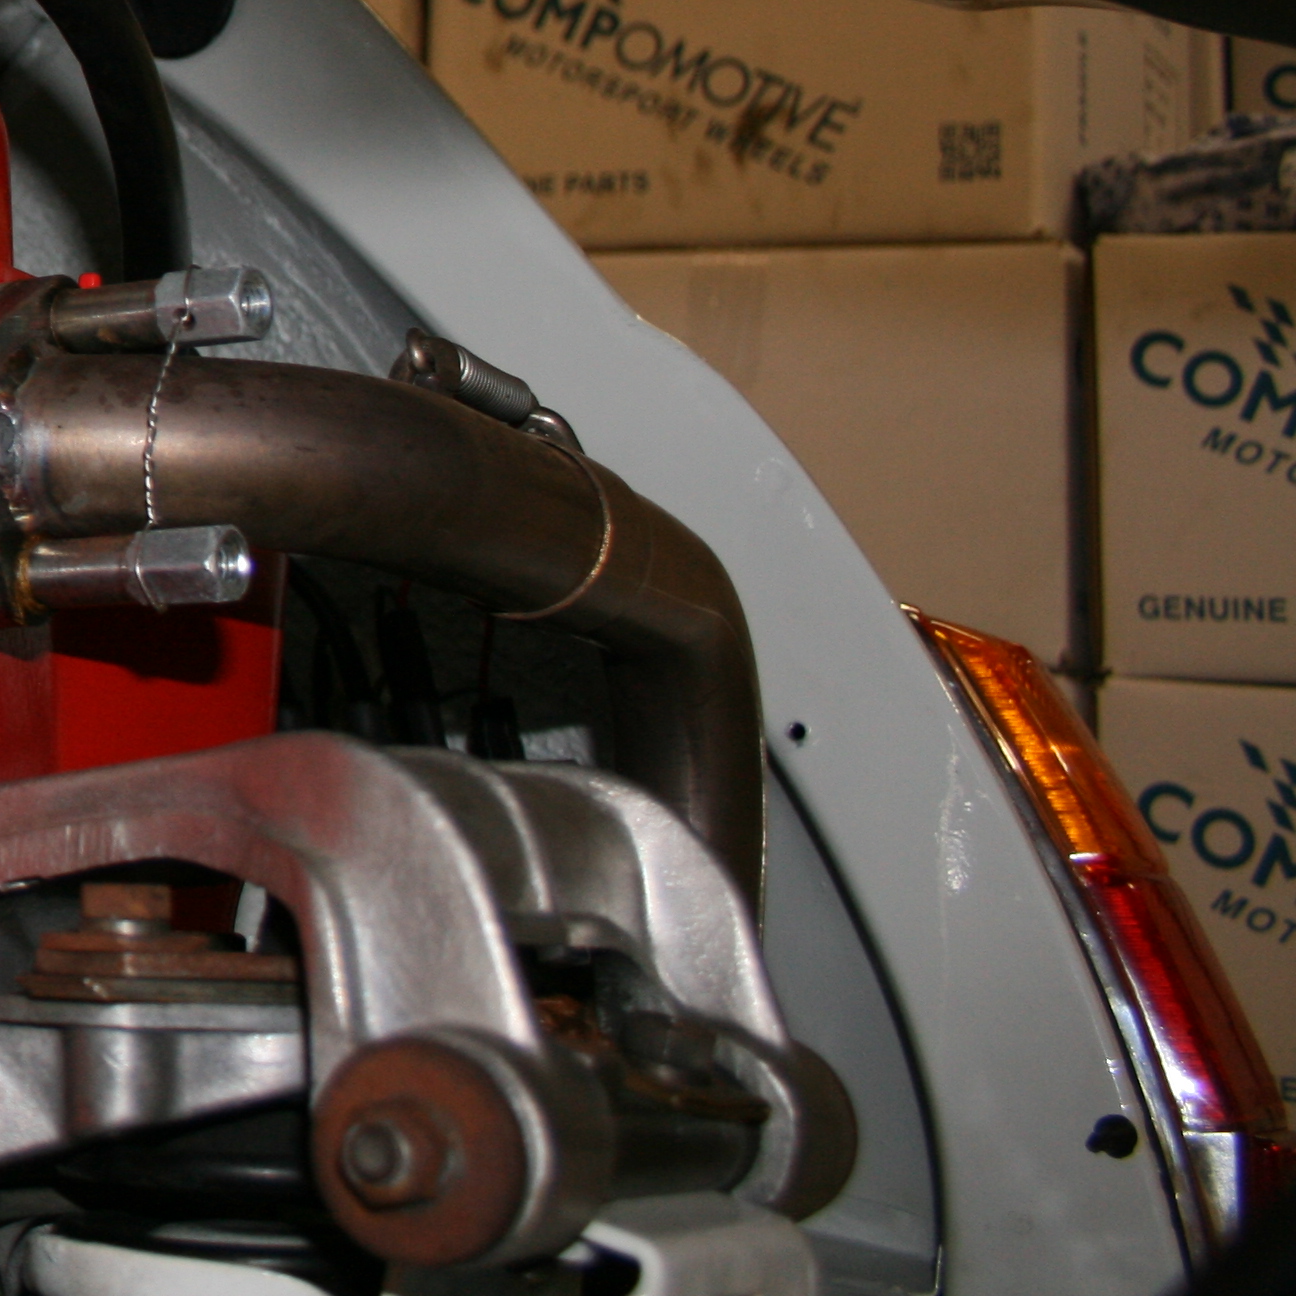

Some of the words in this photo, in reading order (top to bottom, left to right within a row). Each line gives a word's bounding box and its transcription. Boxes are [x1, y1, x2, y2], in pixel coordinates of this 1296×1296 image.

[505, 36, 699, 133] MOTORSPORT
[564, 170, 650, 195] PARTS
[1138, 594, 1288, 623] GENUINE
